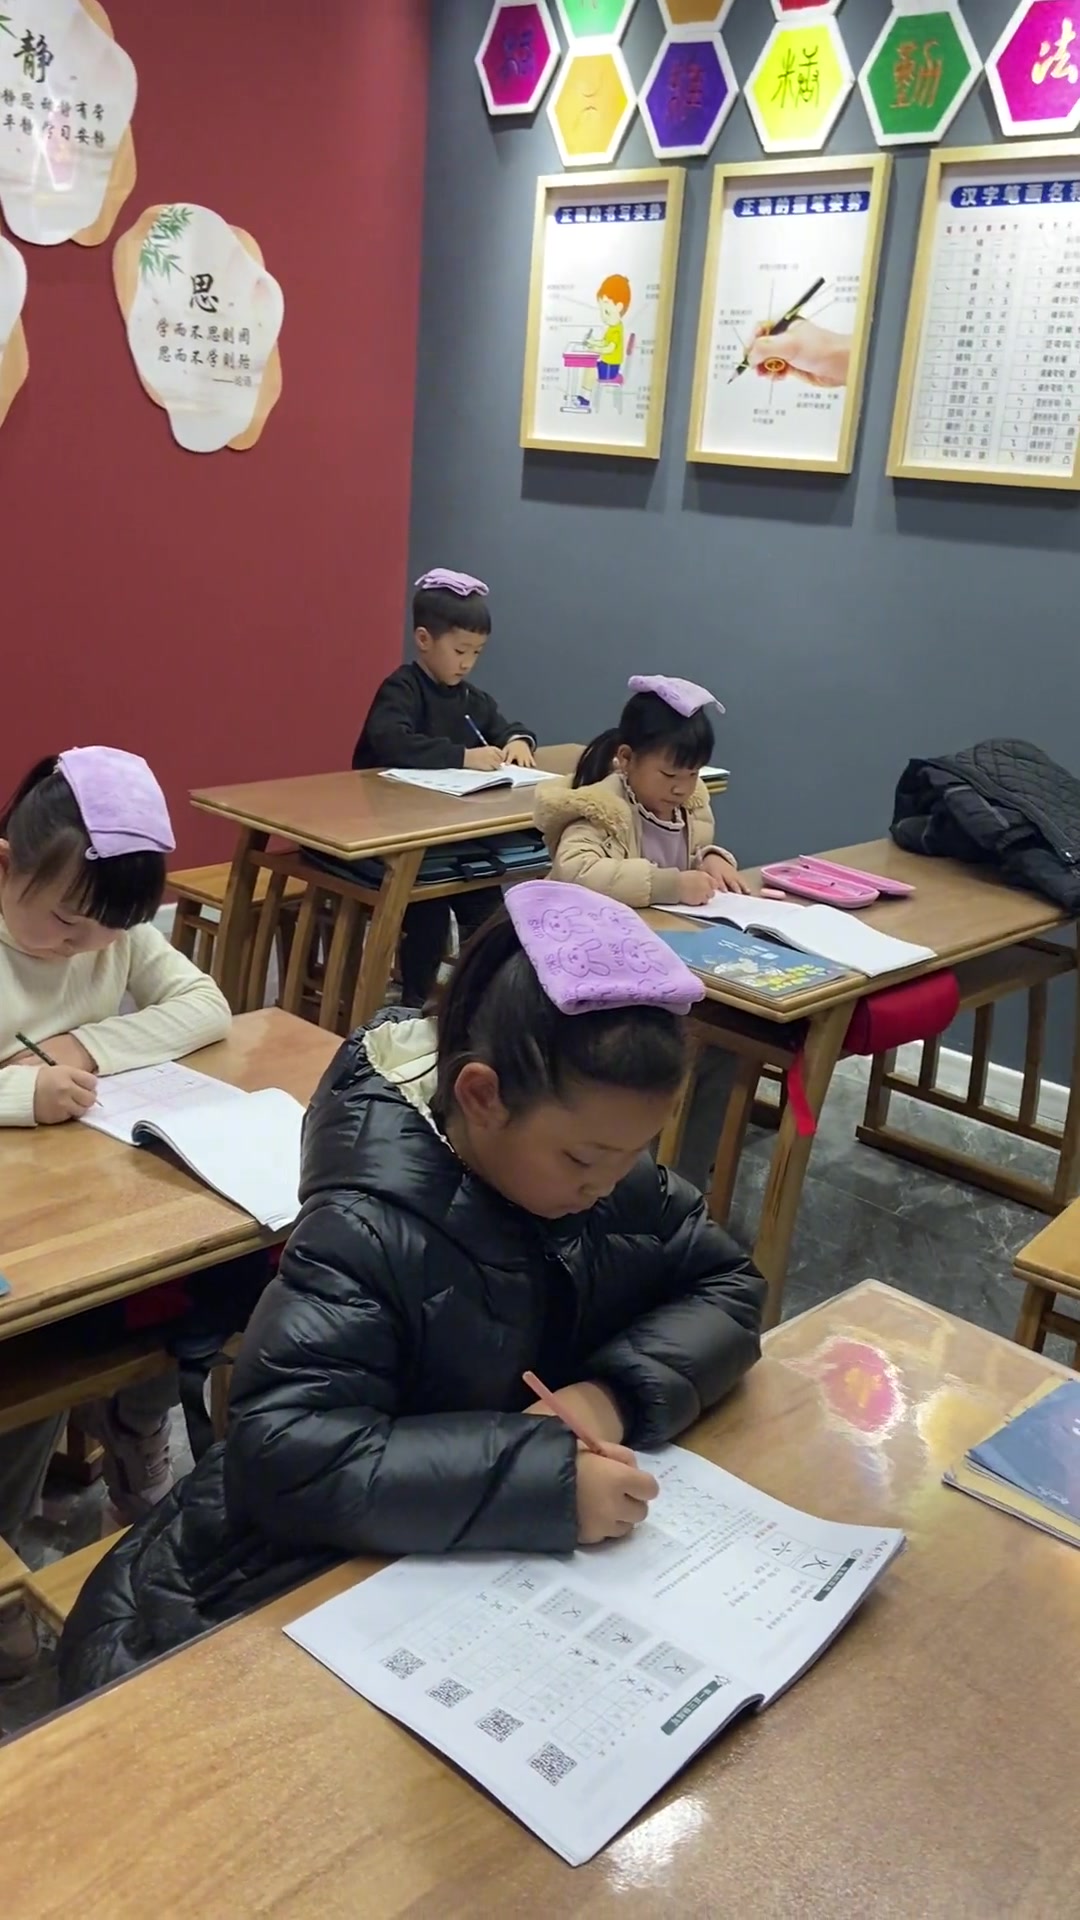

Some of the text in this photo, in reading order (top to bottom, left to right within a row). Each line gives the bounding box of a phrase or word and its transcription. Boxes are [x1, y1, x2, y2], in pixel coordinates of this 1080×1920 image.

[13, 29, 54, 83] 静
[1031, 17, 1080, 84] 法
[189, 273, 219, 313] 思
[771, 1541, 792, 1556] 六
[801, 1554, 831, 1570] 火
